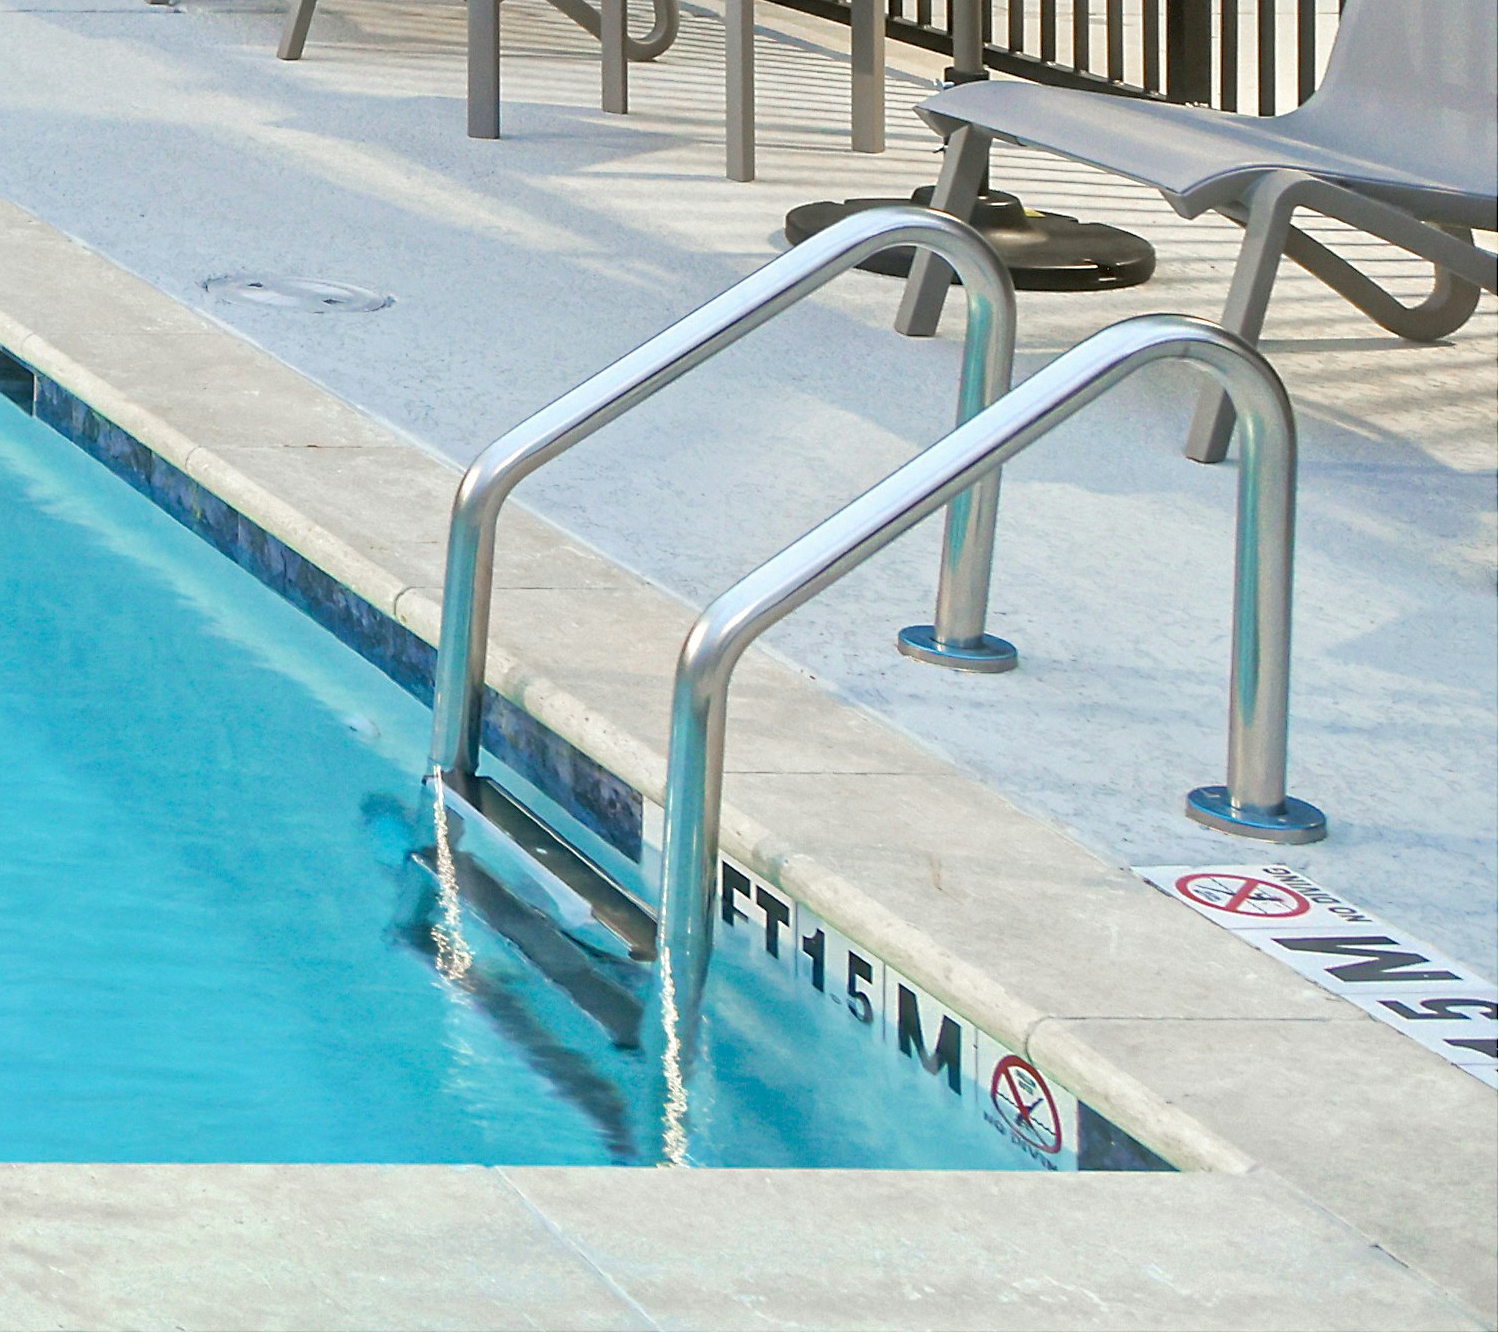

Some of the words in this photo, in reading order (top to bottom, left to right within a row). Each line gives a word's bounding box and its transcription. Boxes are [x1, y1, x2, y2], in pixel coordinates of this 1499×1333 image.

[1263, 866, 1333, 905] DIVING
[1329, 906, 1373, 923] NO
[722, 860, 789, 959] FT
[898, 982, 961, 1096] M
[1271, 935, 1464, 983] M
